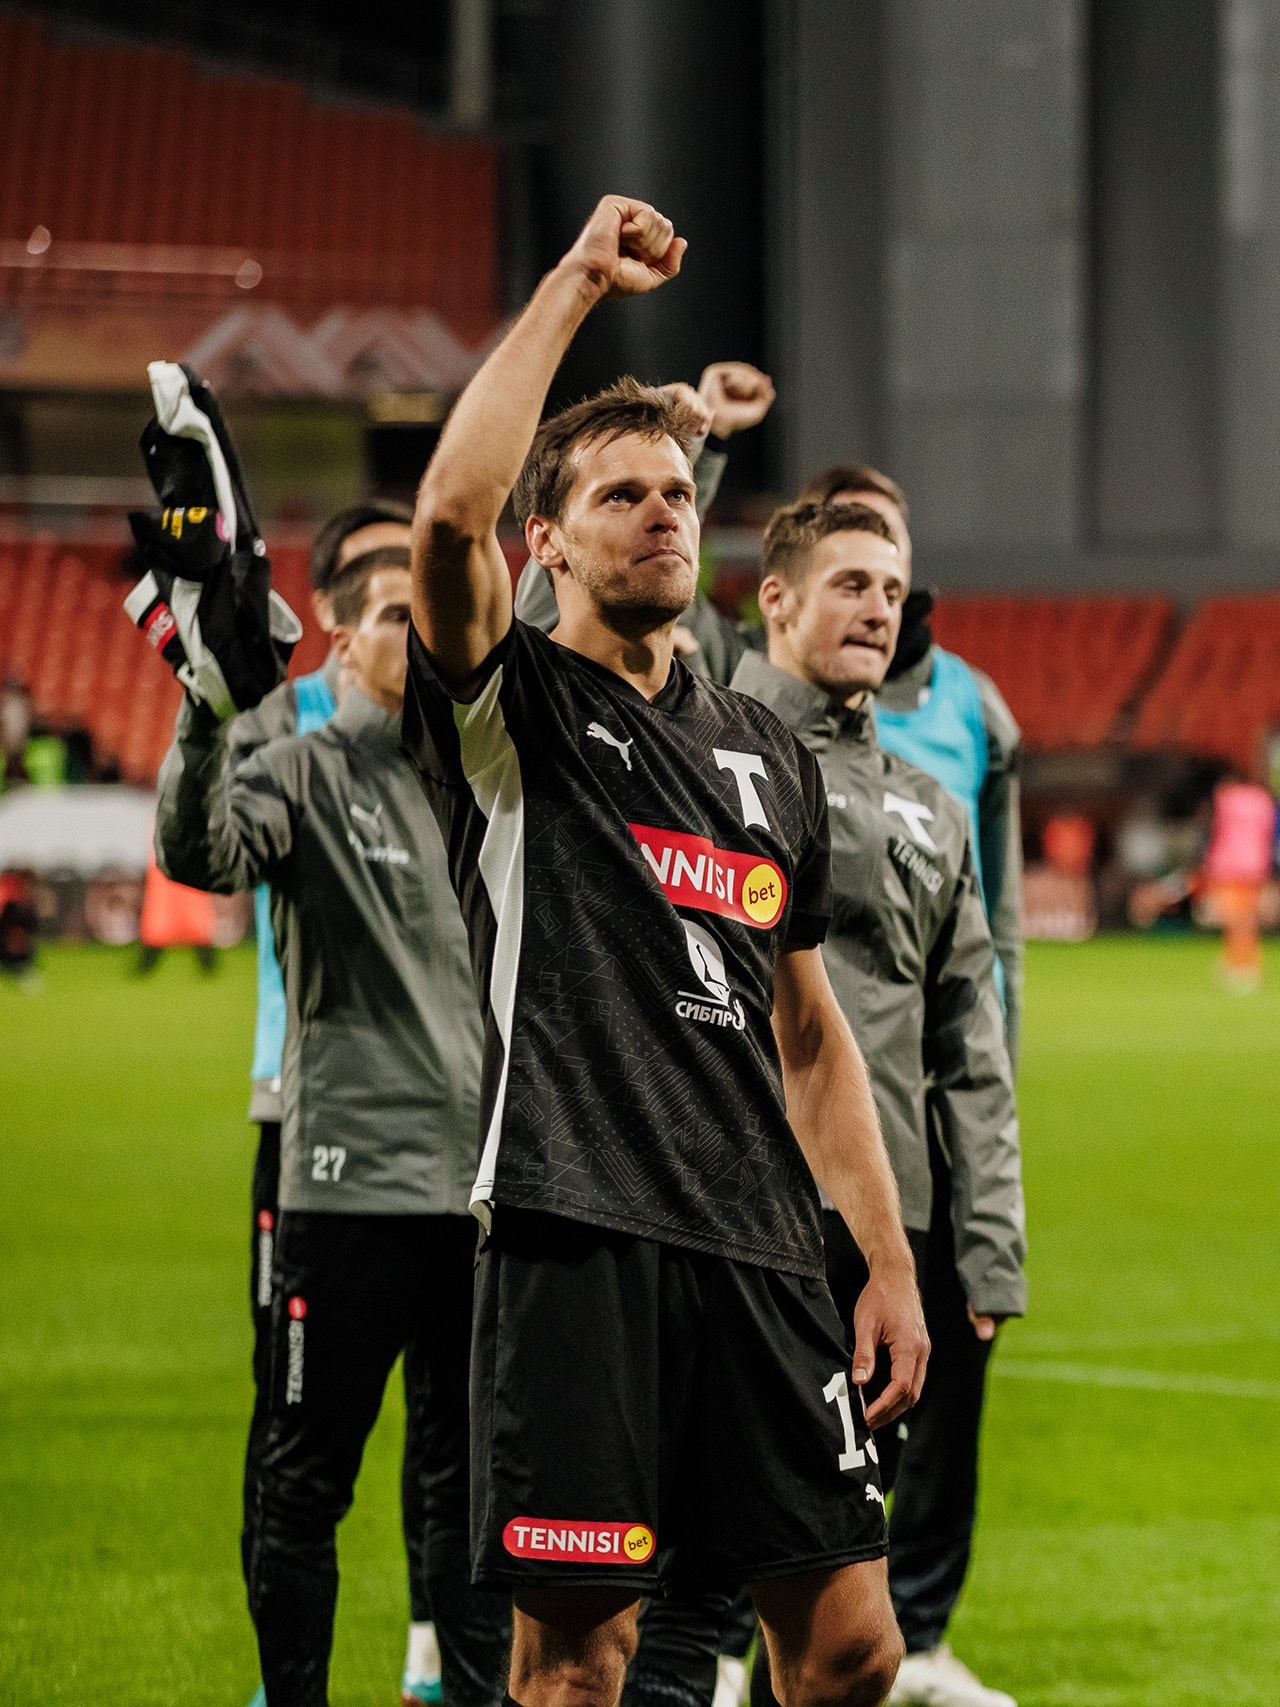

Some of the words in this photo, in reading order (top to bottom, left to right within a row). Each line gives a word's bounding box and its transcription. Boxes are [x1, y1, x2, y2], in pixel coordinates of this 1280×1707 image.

[712, 747, 771, 832] T
[640, 842, 735, 905] NNISI
[748, 881, 777, 905] bet
[675, 1000, 746, 1031] СИБПРО
[311, 1144, 347, 1182] 27
[512, 1525, 620, 1554] TENNISI
[627, 1535, 649, 1551] bet
